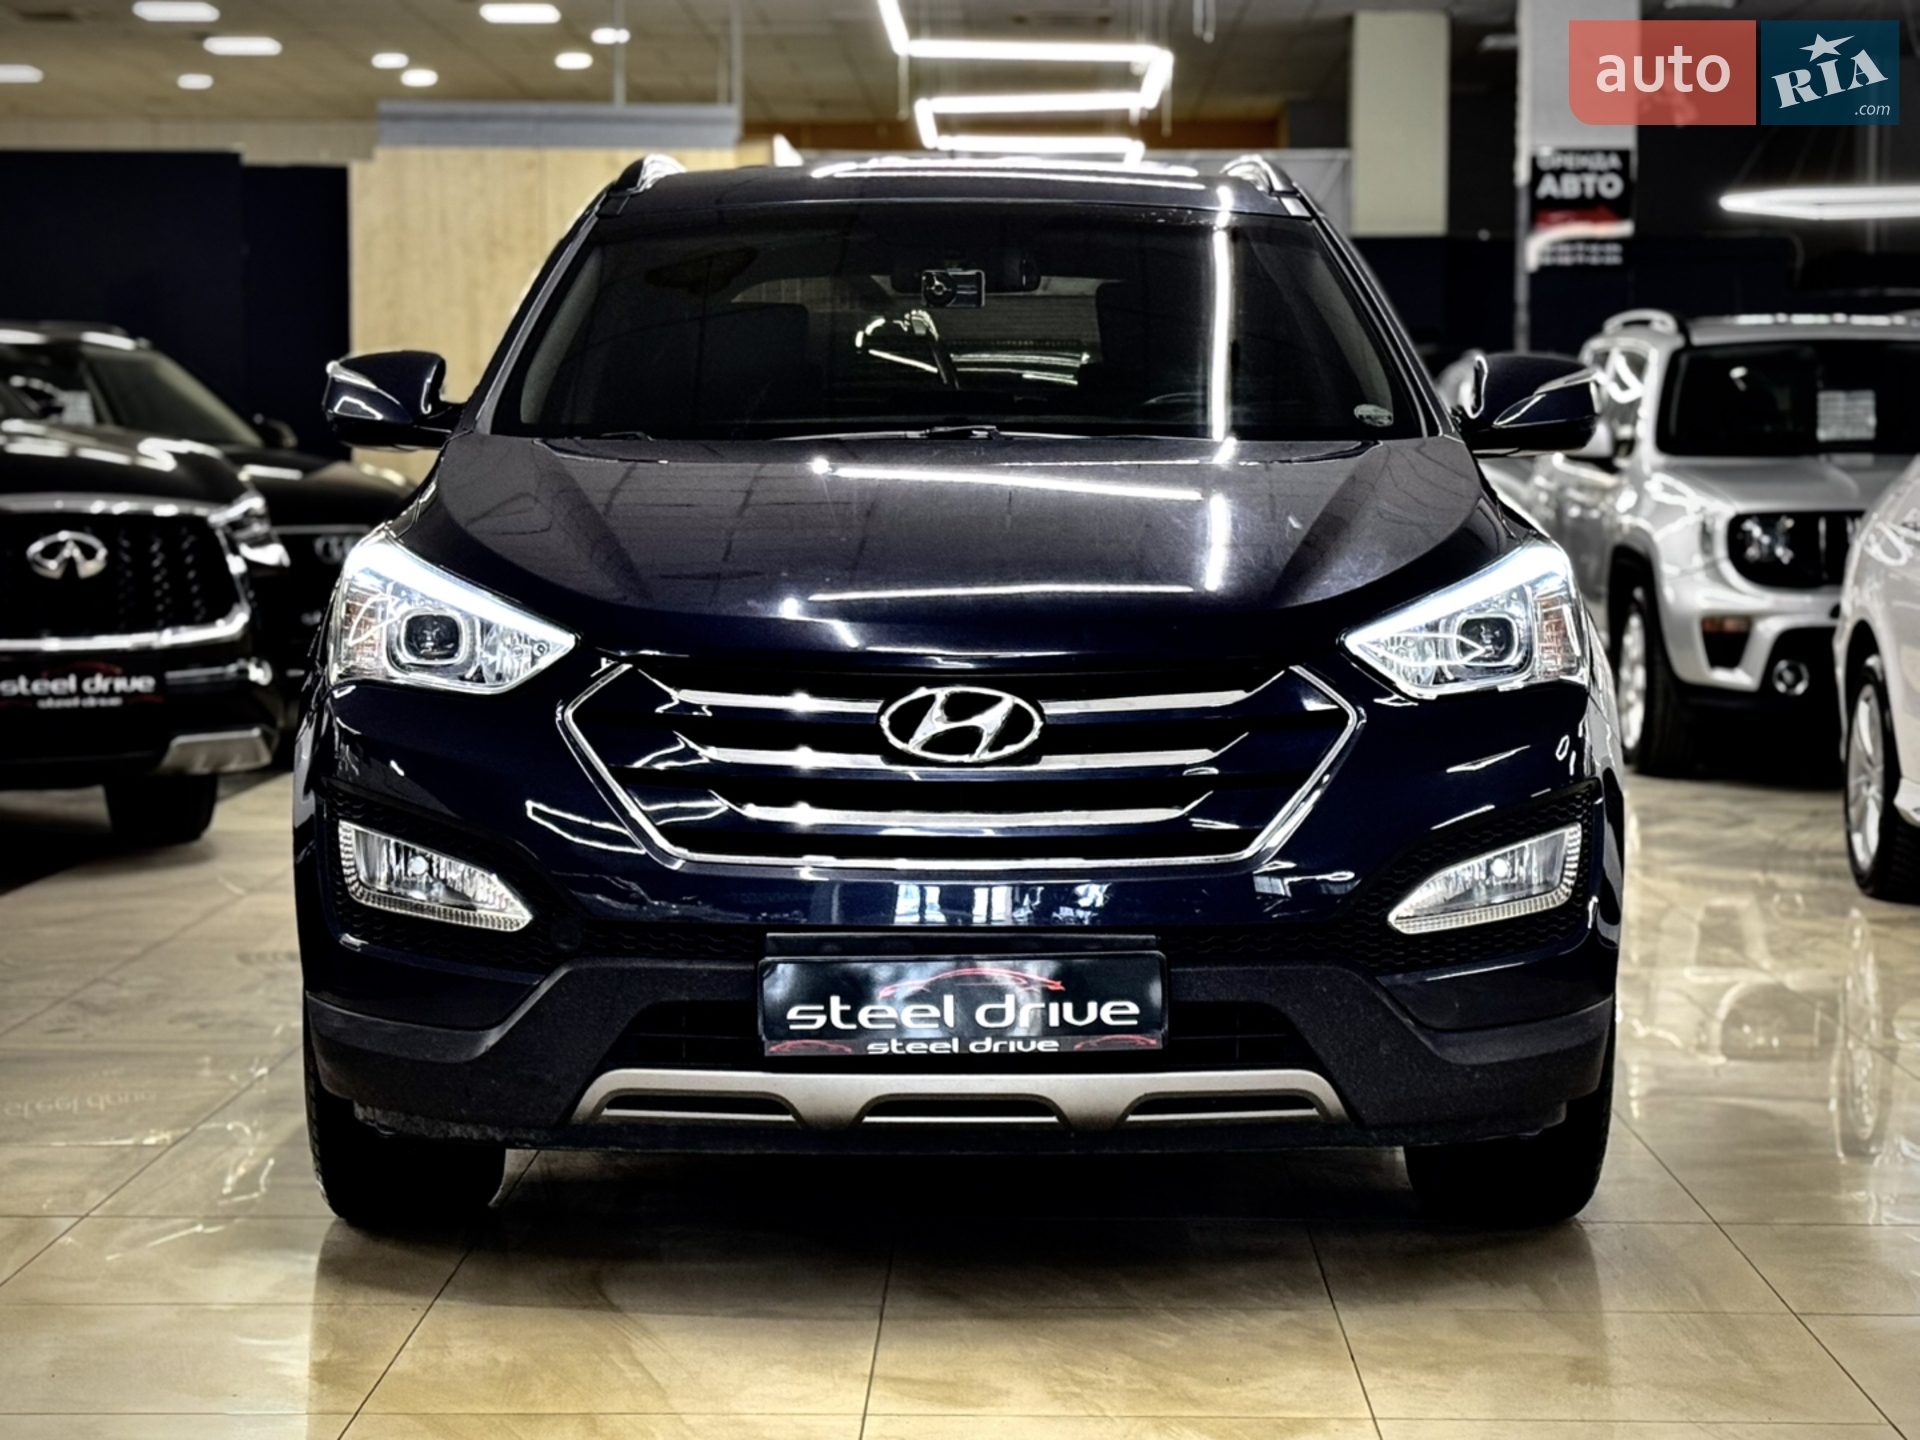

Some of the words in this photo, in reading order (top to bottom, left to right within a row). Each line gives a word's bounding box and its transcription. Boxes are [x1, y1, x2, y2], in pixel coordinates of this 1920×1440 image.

[1536, 172, 1624, 199] АВТО
[0, 674, 77, 696] steel
[82, 673, 156, 694] drive
[786, 994, 954, 1030] steel
[975, 994, 1140, 1029] drive
[867, 1038, 959, 1055] steel
[969, 1037, 1060, 1053] drive
